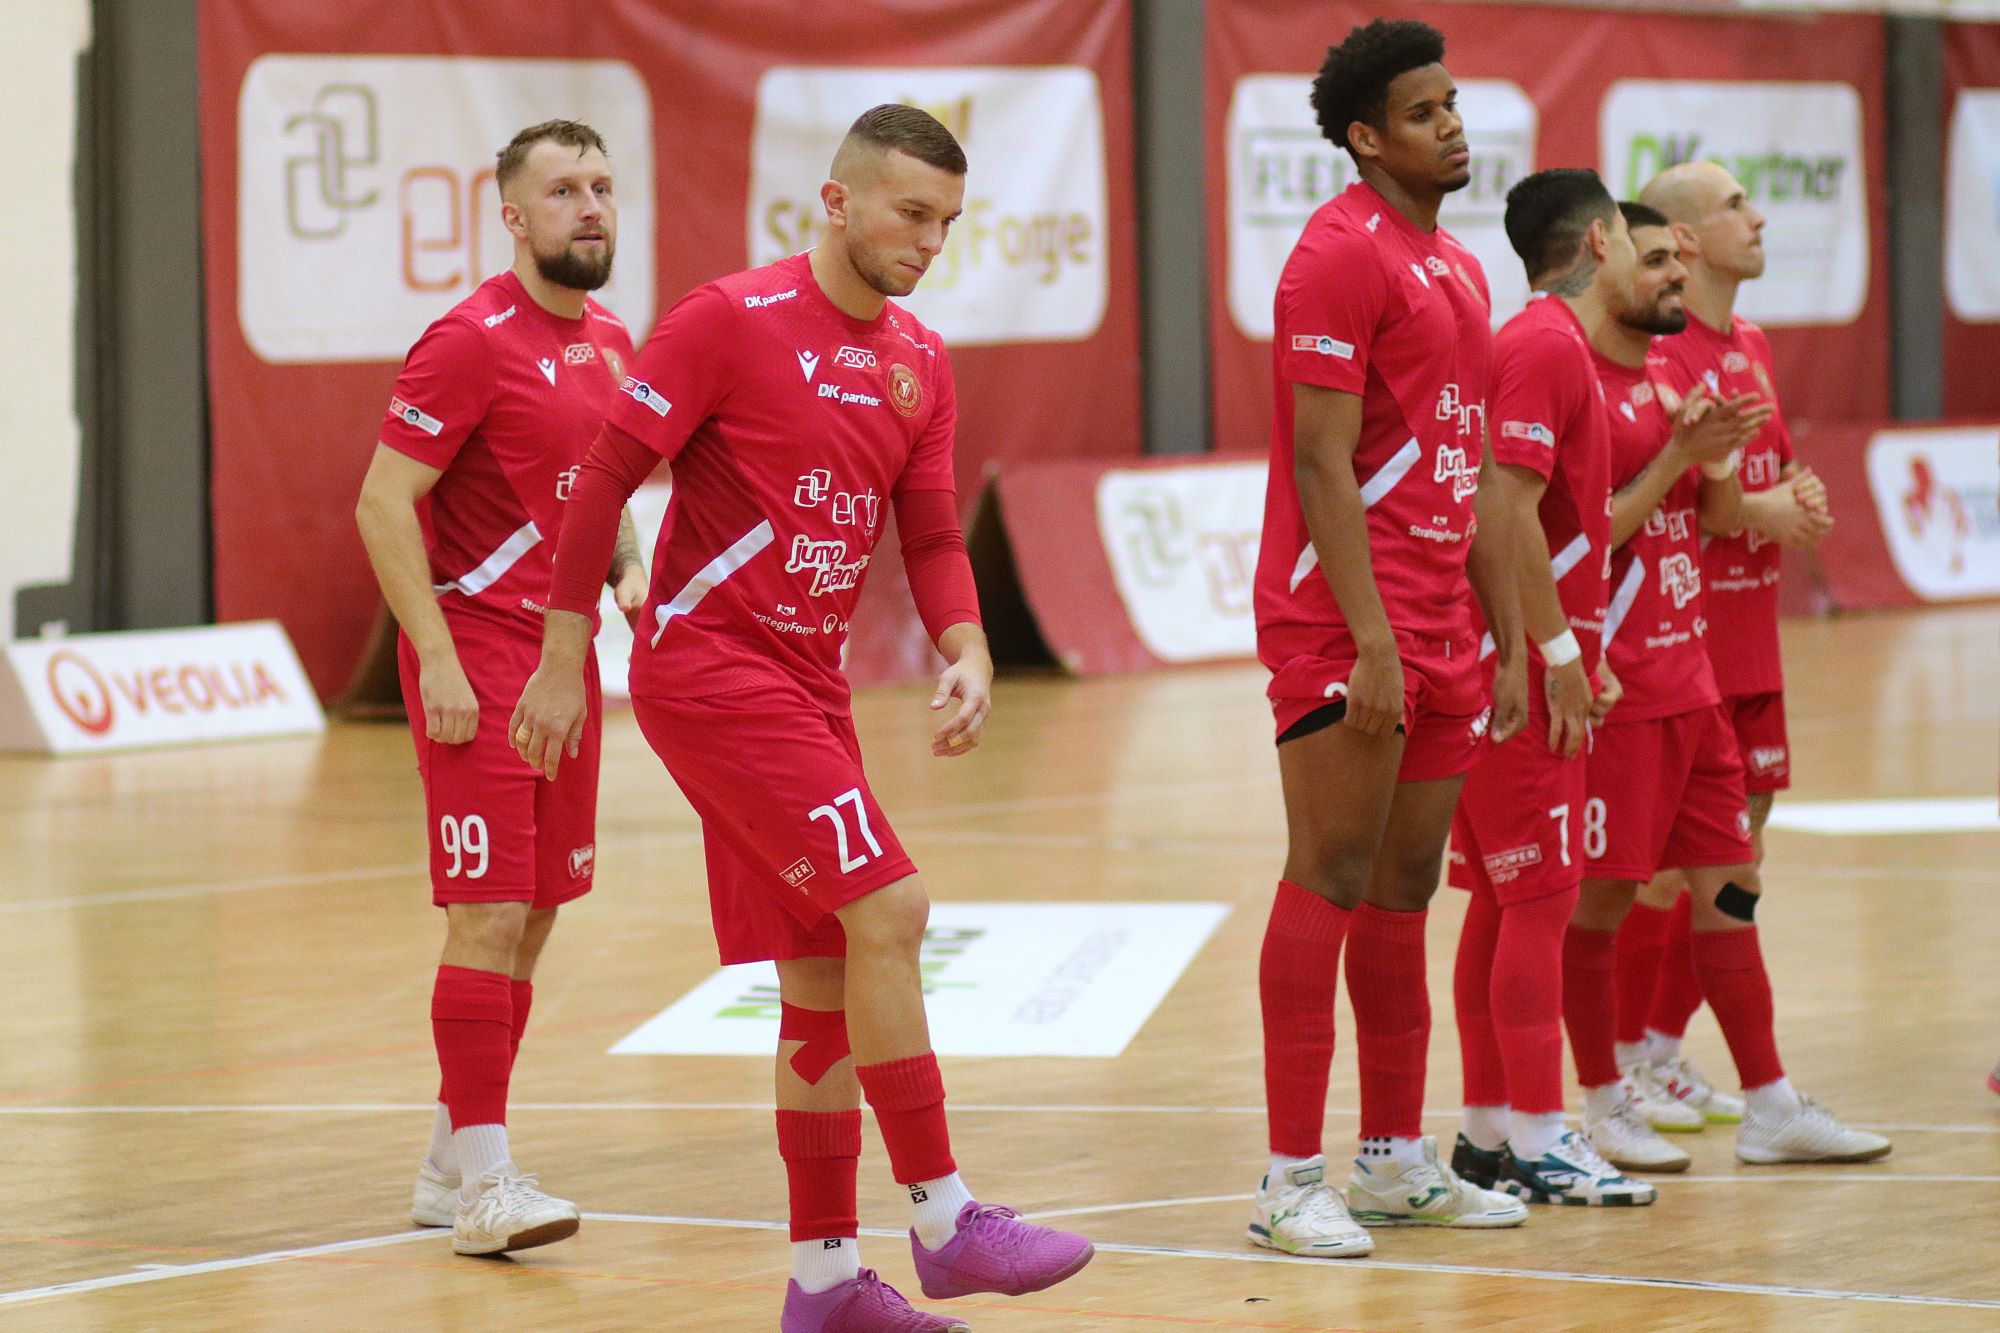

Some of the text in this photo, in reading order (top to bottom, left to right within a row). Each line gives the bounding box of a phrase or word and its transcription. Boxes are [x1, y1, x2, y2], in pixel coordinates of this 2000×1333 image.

[833, 345, 877, 369] Fogo
[817, 383, 882, 407] DK partner
[111, 661, 288, 714] VEOLIA
[440, 814, 490, 879] 99
[808, 787, 884, 875] 27
[1548, 803, 1572, 867] 7
[1583, 797, 1608, 859] 8
